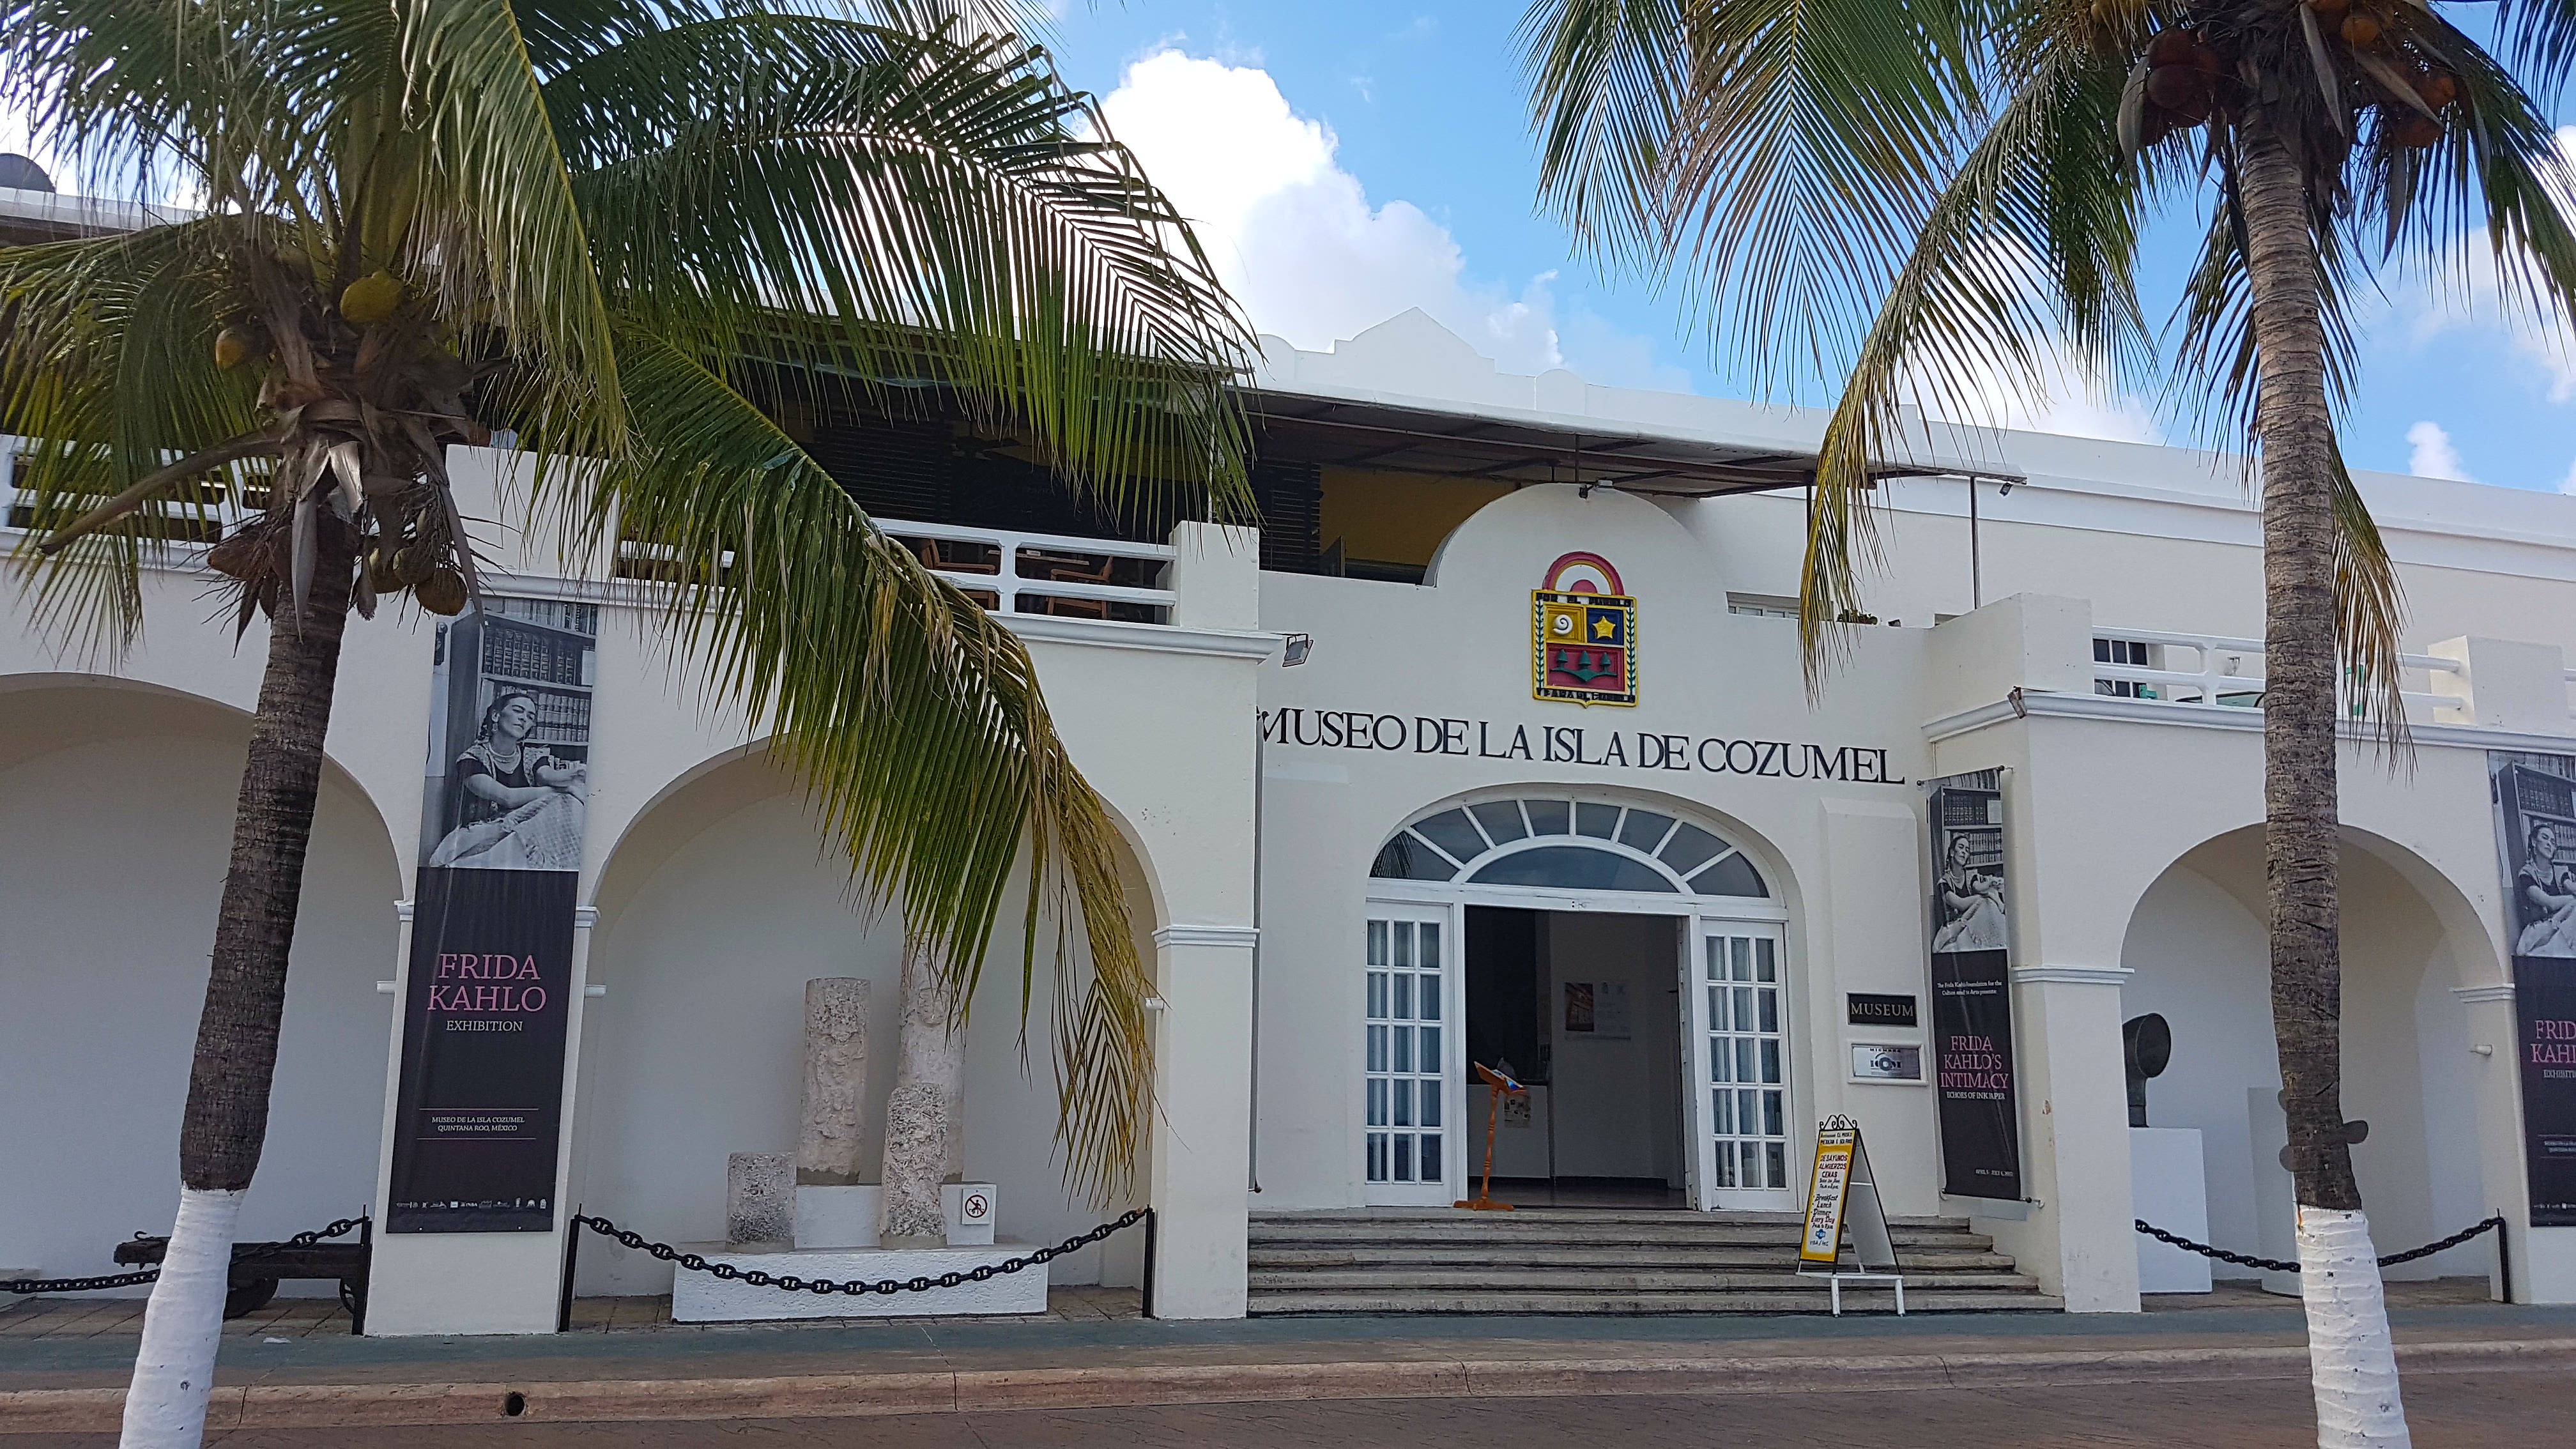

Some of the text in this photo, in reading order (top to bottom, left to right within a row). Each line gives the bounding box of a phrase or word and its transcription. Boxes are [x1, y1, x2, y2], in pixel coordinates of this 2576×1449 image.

[1256, 705, 1906, 785] MUSEO DE LA ISLA DE COZUMEL
[438, 953, 541, 980] FRIDA
[427, 985, 547, 1012] KAHLO
[1851, 1002, 1914, 1017] MUSEUM
[446, 1020, 523, 1032] EXHIBITION
[1951, 1036, 1993, 1052] FRIDA
[1944, 1054, 2003, 1070] KAHLO'S
[1940, 1072, 2009, 1089] INTIMACY
